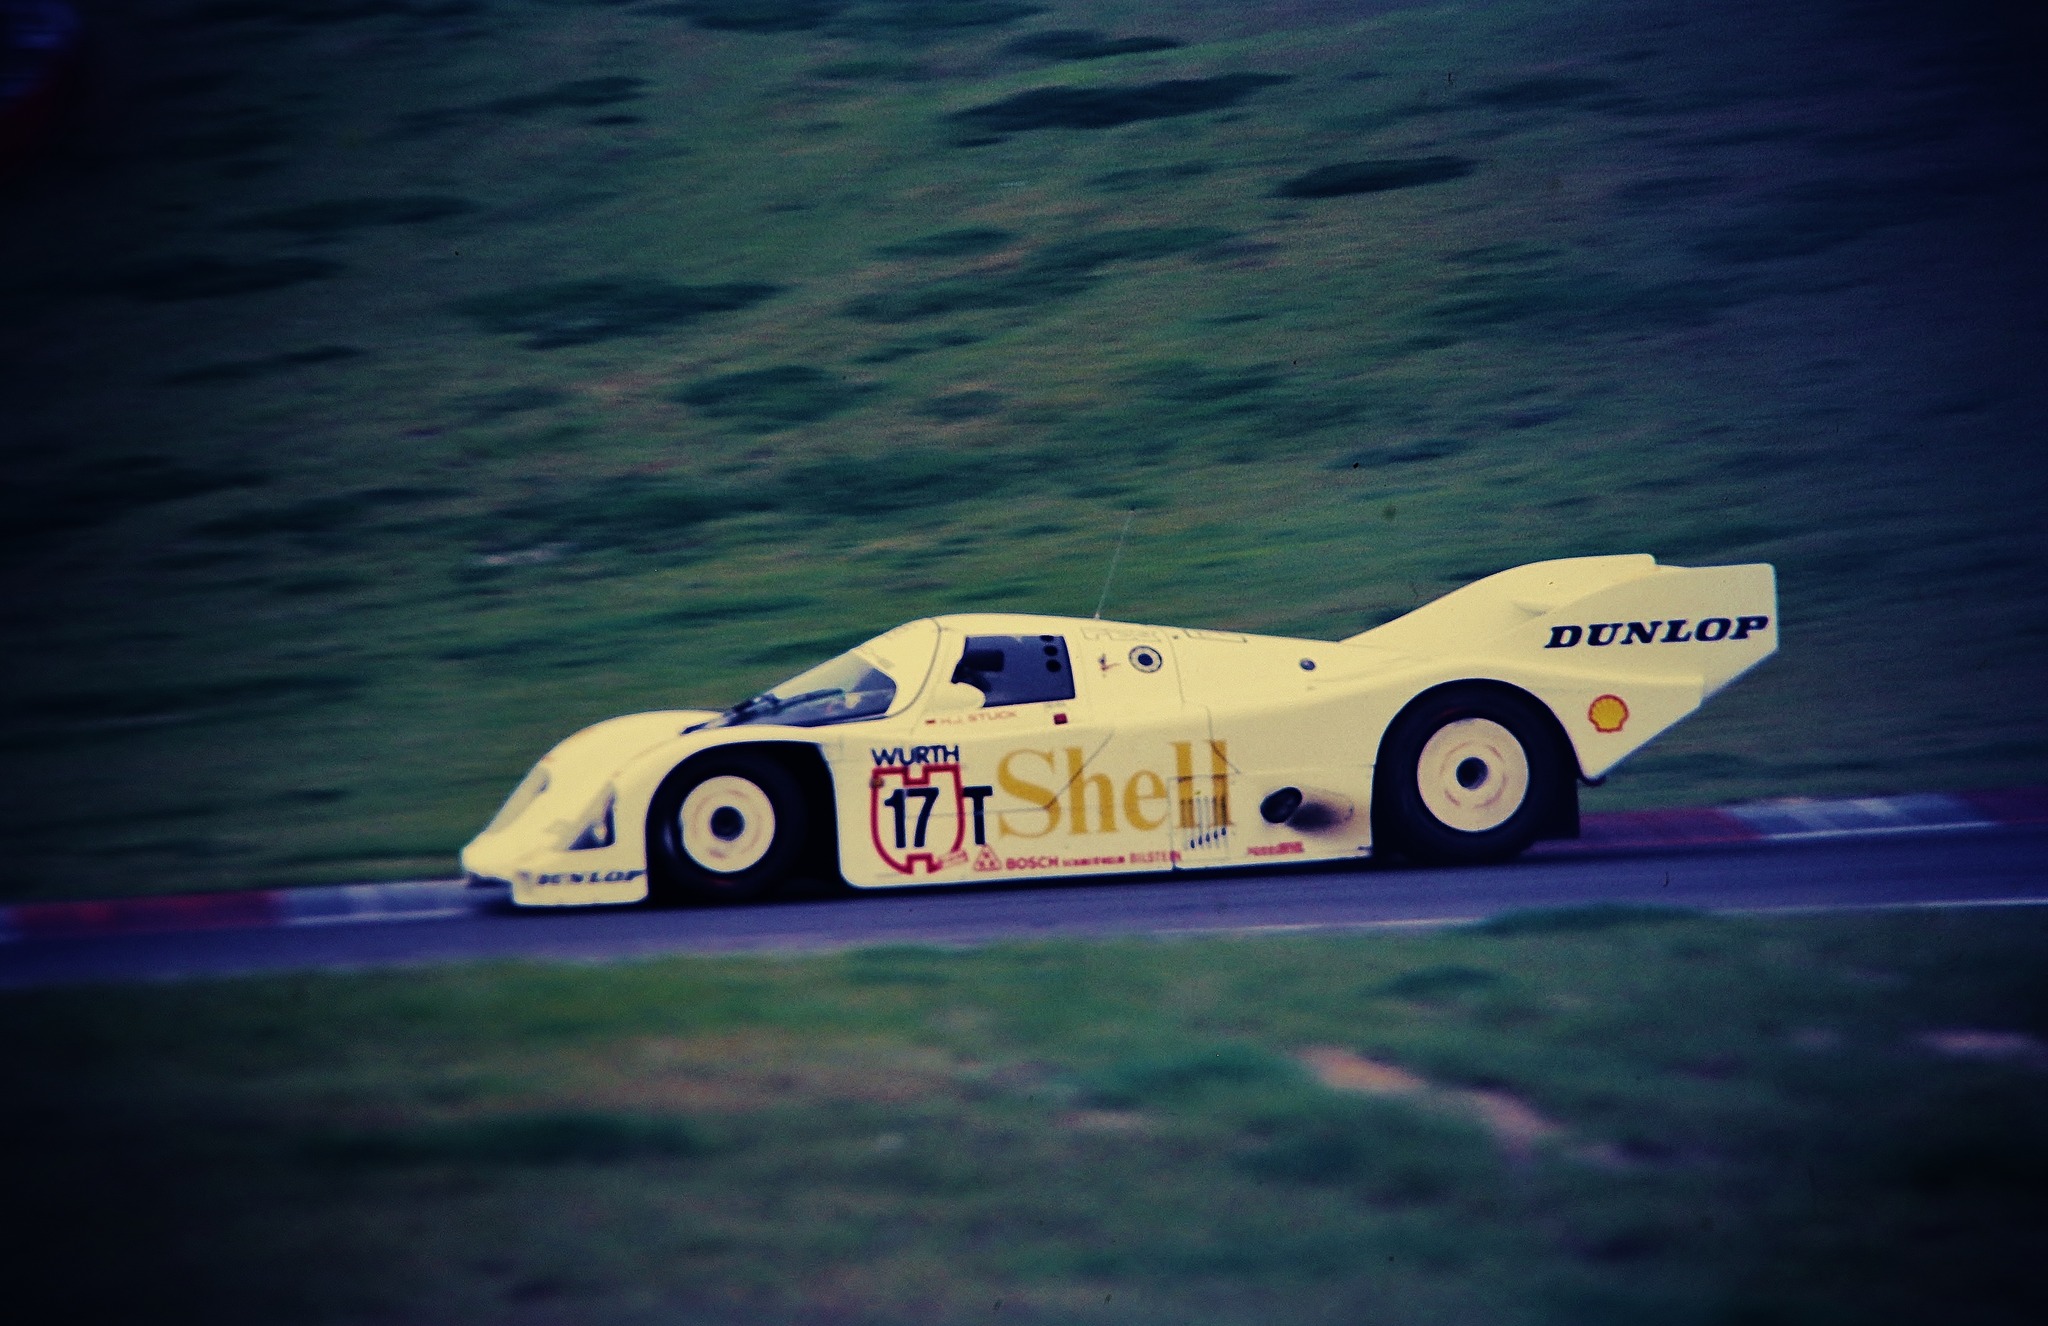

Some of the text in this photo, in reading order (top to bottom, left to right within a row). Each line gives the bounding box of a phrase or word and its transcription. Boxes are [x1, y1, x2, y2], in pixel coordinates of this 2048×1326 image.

[1545, 615, 1769, 648] DUNLOP
[871, 743, 959, 765] WURTH
[997, 740, 1236, 839] Shell
[884, 785, 993, 848] 17 T
[1006, 856, 1059, 869] BOSCH
